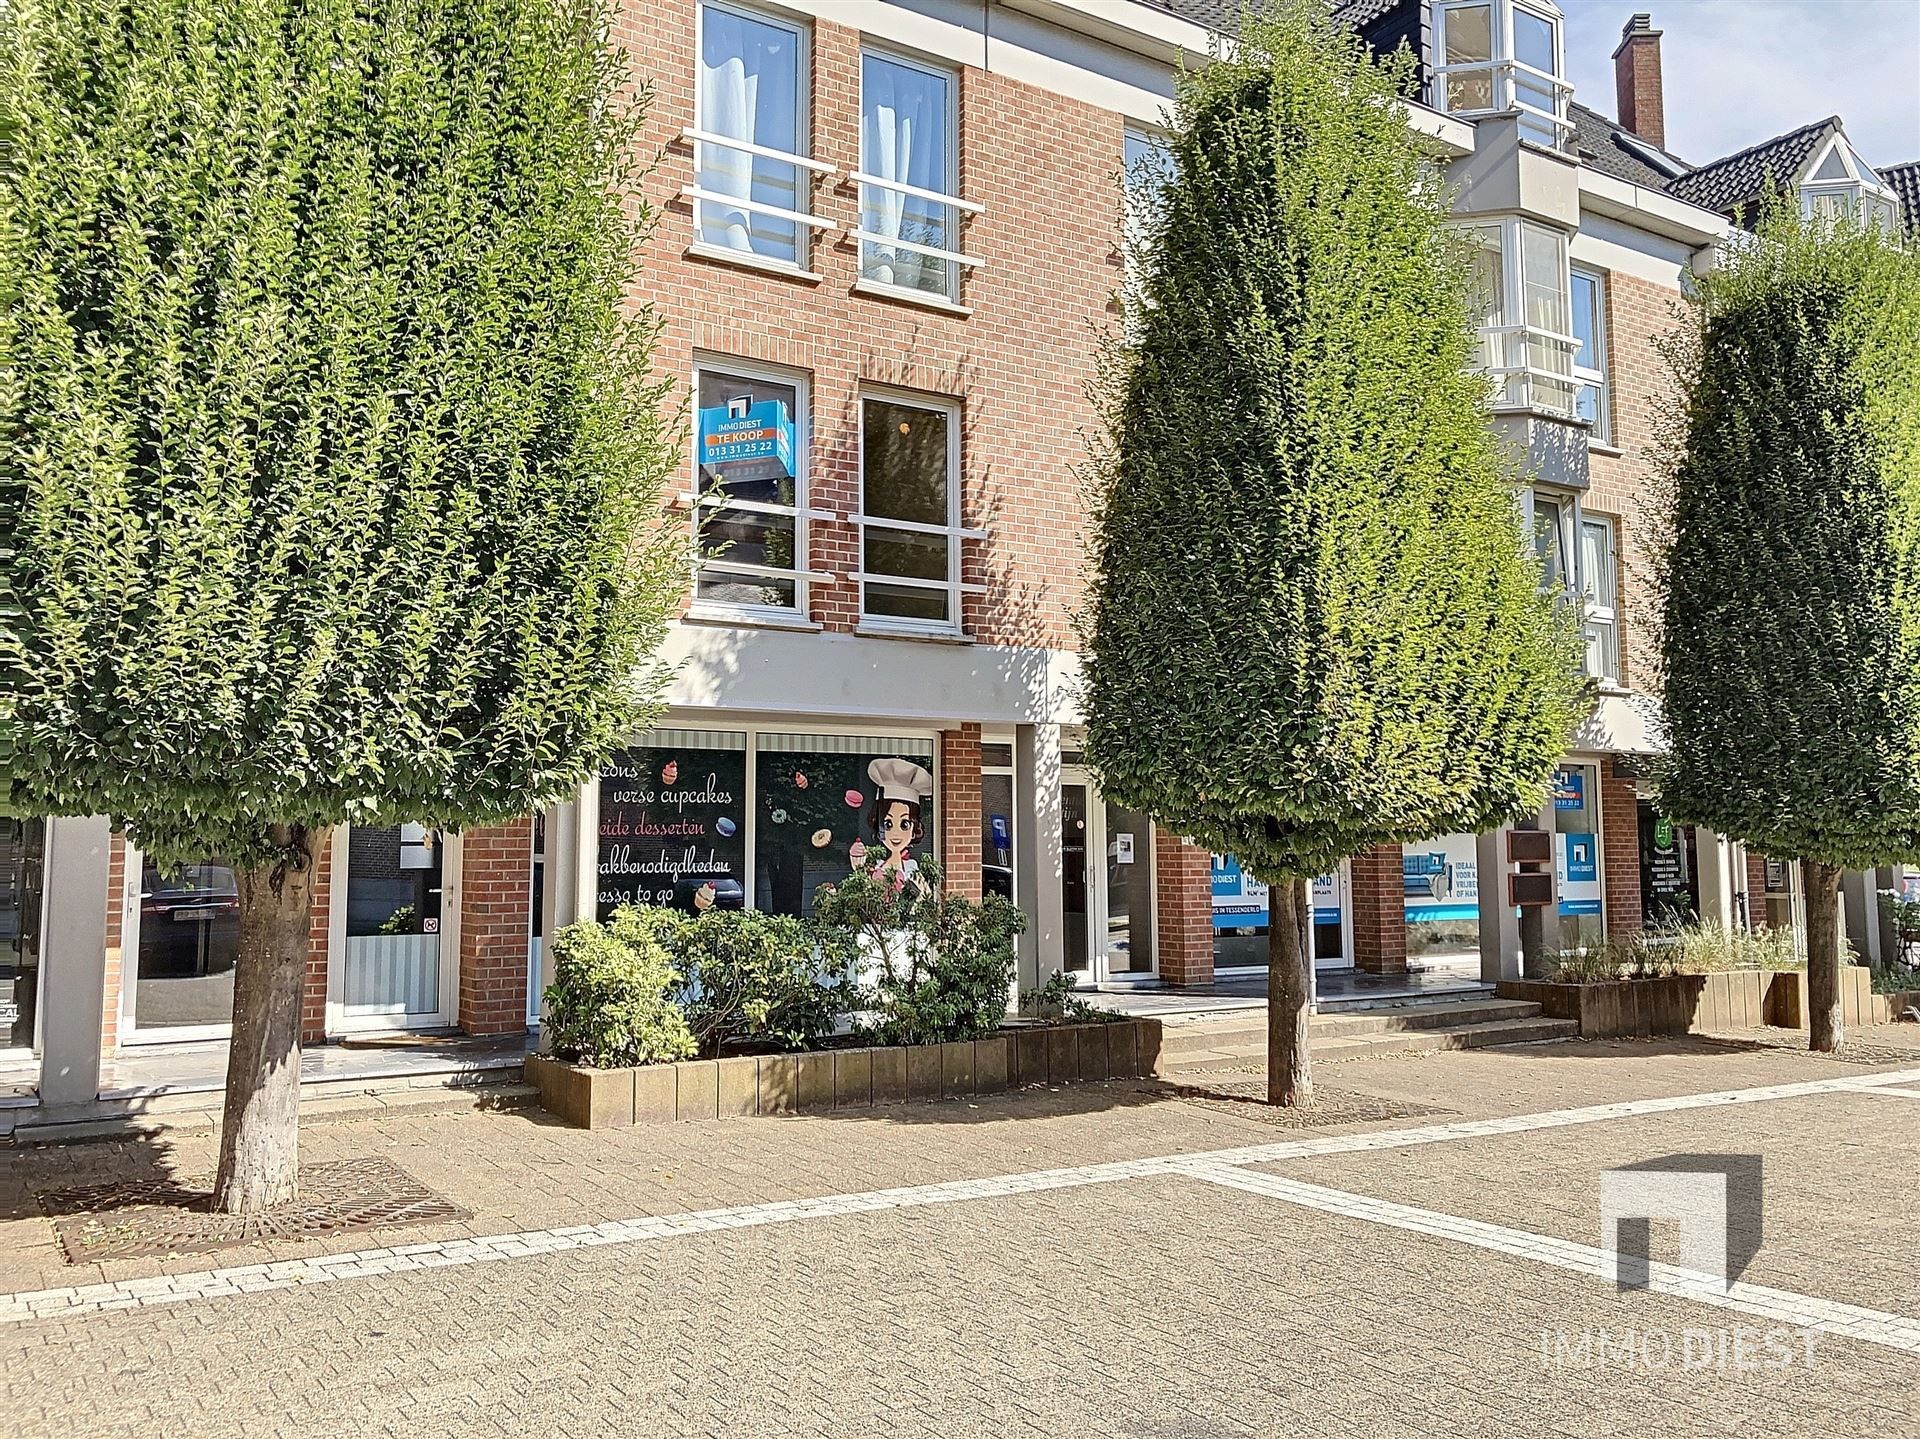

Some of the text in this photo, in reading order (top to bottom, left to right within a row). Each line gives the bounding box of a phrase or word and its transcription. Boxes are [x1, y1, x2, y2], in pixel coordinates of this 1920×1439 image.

[718, 419, 762, 432] IMMO DIEST
[717, 430, 764, 444] TE KOOP
[708, 441, 772, 457] 013 31 25 22
[601, 766, 639, 778] rons
[613, 772, 733, 814] verse cupcakes
[634, 810, 705, 836] desserten
[598, 844, 732, 884] akbenodigdheden
[1455, 862, 1476, 870] IDEAAL
[1217, 875, 1237, 884] DIEST
[1455, 871, 1471, 879] VOOR
[598, 884, 674, 909] esso to go
